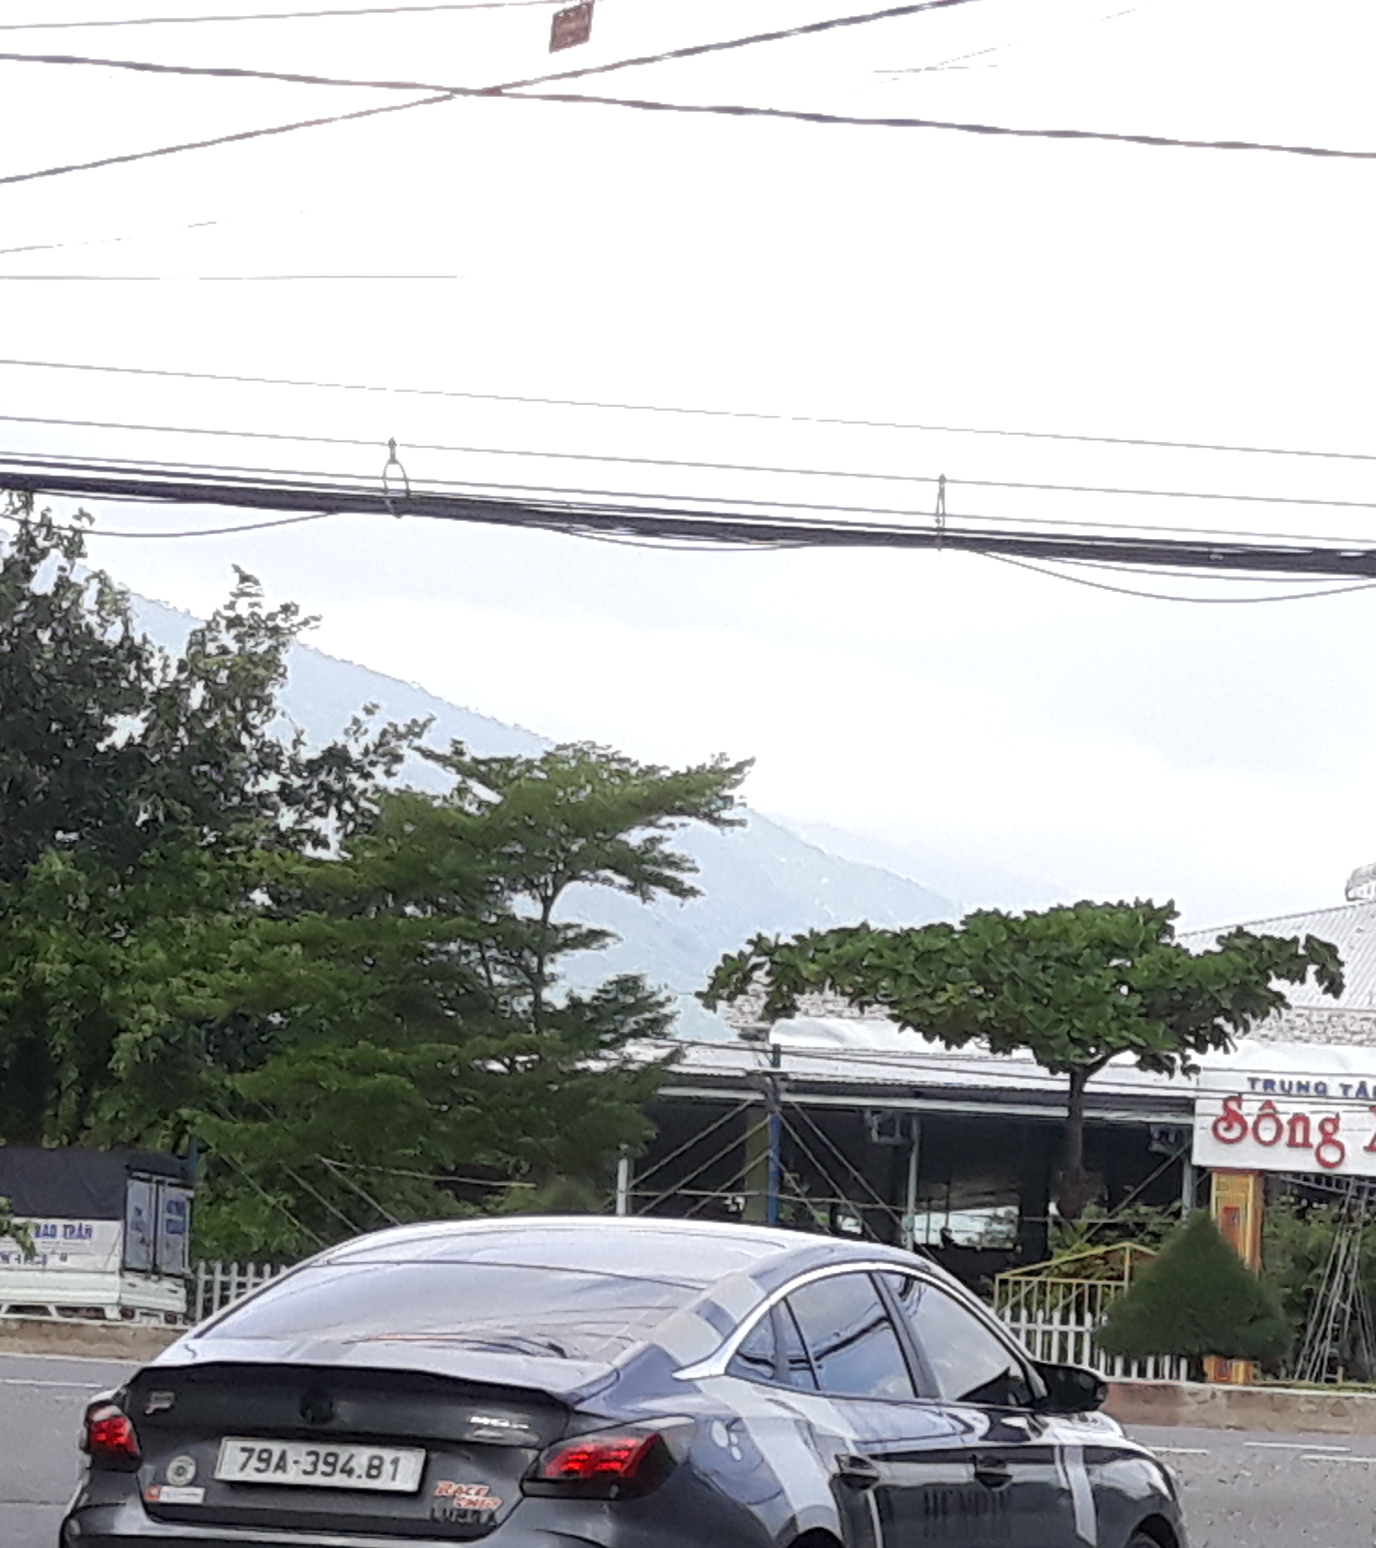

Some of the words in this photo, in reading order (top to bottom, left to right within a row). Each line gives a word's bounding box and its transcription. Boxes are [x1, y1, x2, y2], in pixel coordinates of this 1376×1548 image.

[1246, 1076, 1328, 1095] TRUNG
[1211, 1093, 1346, 1169] Sông
[239, 1446, 401, 1482] 79A-394.81
